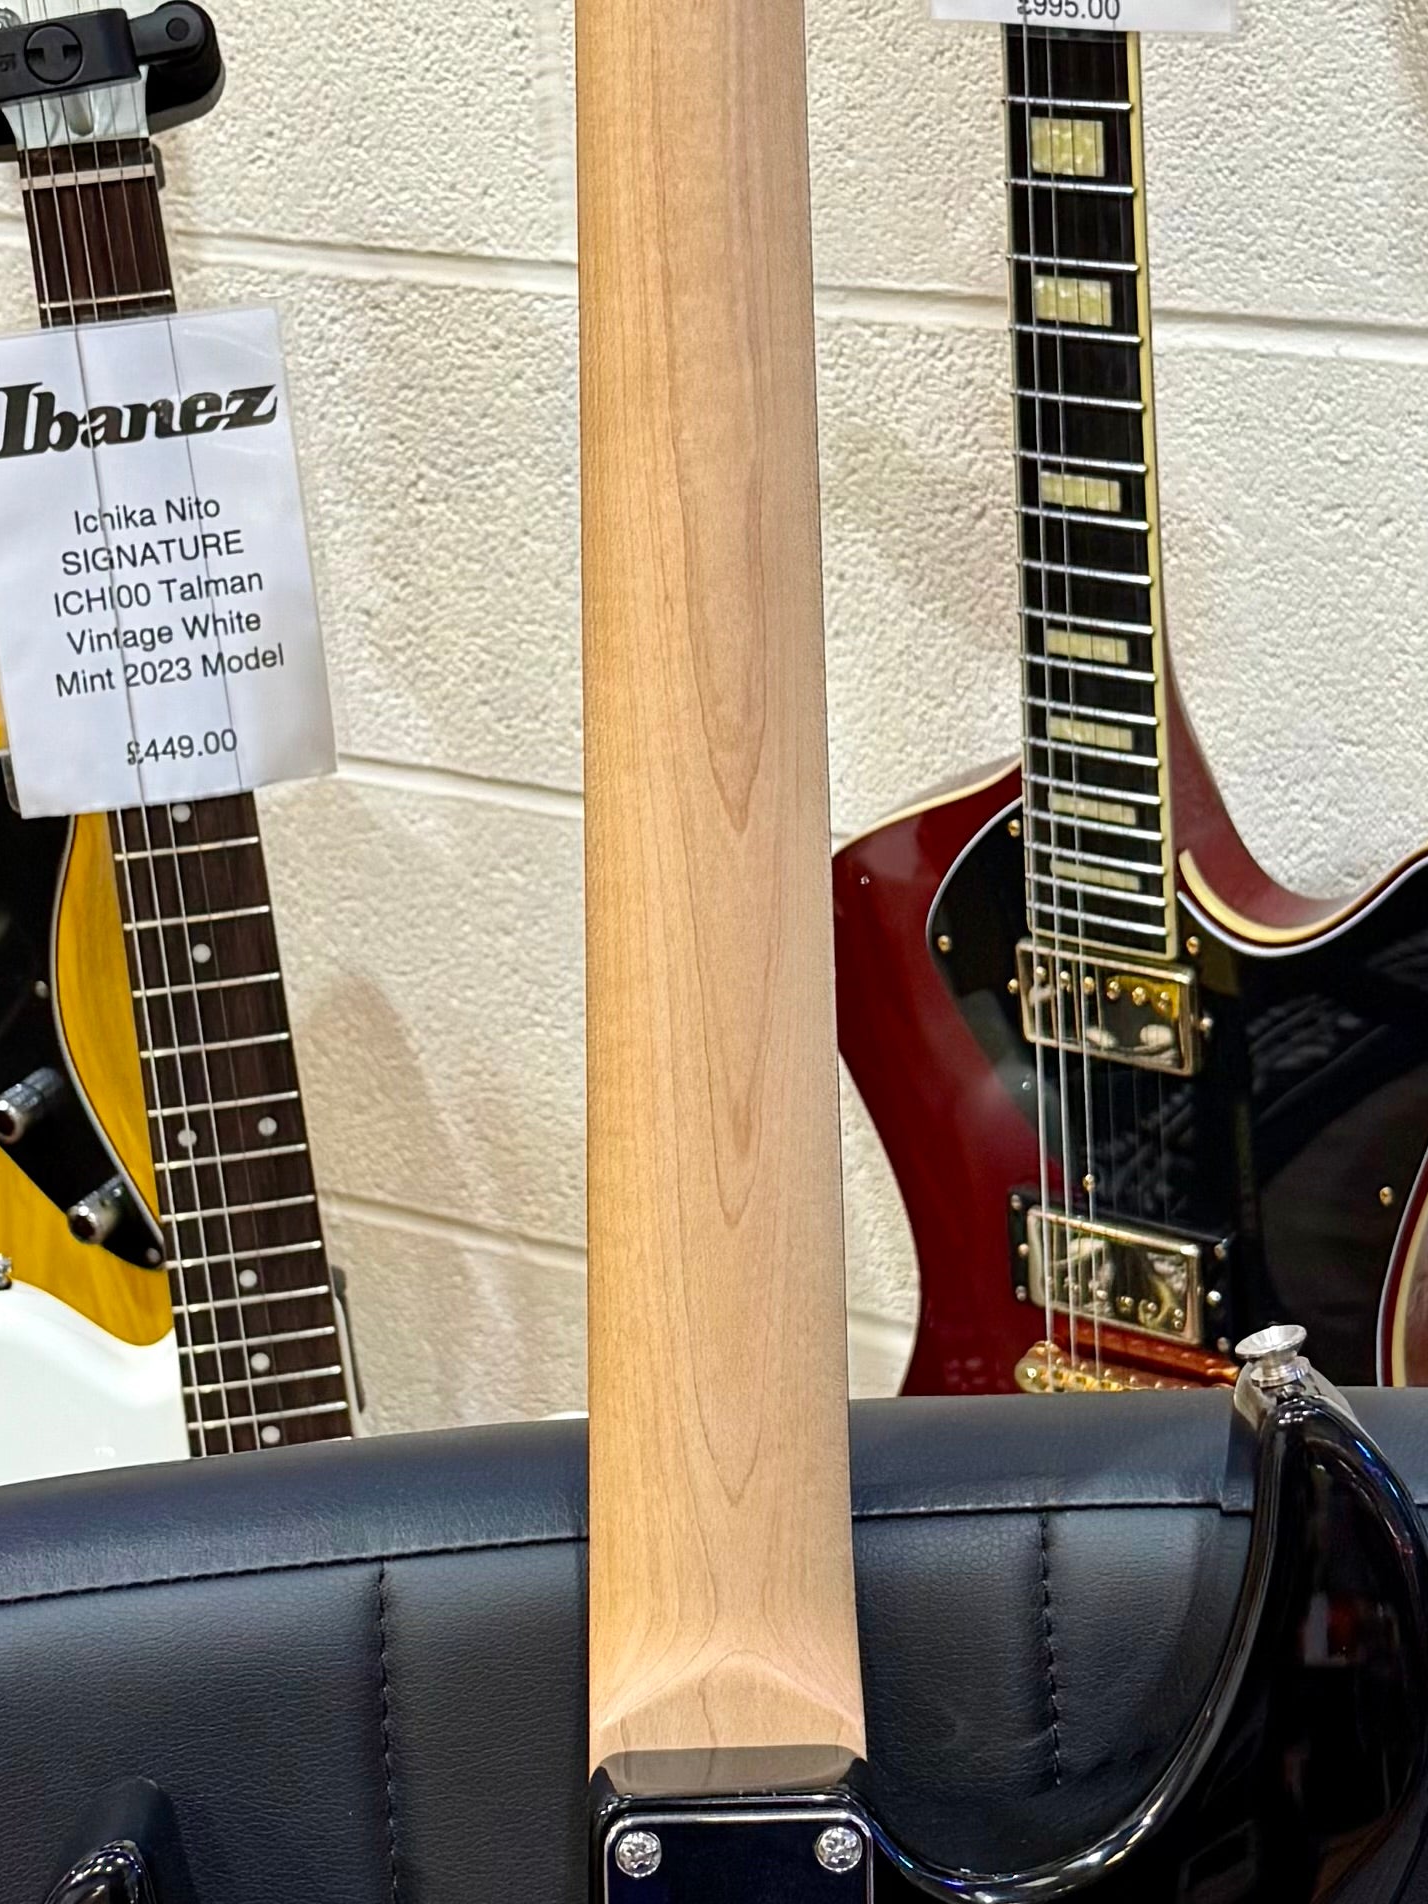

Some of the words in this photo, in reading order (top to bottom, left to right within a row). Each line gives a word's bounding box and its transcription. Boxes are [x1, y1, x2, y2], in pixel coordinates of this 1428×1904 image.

[75, 504, 156, 535] Ichika
[166, 498, 220, 523] Nito
[62, 530, 244, 575] SIGNATURE
[164, 572, 263, 606] Talman
[67, 623, 172, 656] Vintage
[182, 612, 262, 641] White
[56, 670, 115, 697] Mint
[125, 658, 192, 687] 2023
[202, 645, 284, 678] Model
[127, 729, 237, 764] £449.00
